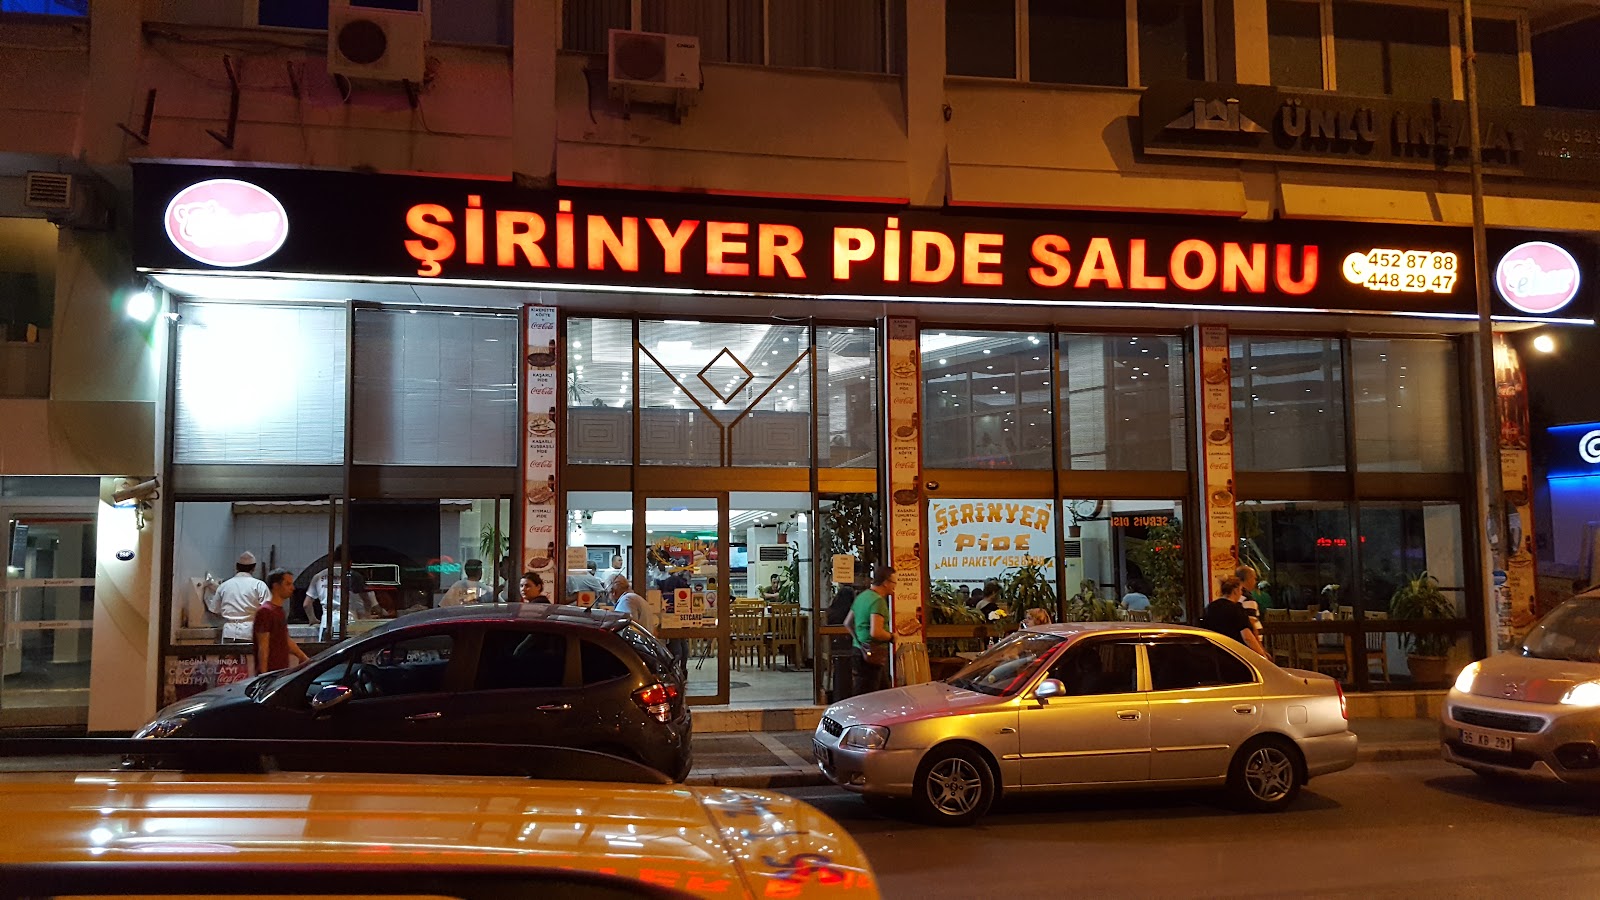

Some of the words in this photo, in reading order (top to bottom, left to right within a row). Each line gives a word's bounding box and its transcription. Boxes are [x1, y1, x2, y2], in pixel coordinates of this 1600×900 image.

[1281, 97, 1378, 143] ÜNLÜ
[404, 194, 808, 278] ŞİRİNYER
[833, 217, 1005, 287] PİDE
[1028, 234, 1320, 295] SALONU
[1369, 252, 1401, 269] 452
[1407, 254, 1428, 270] 87
[1433, 255, 1454, 271] 88
[1367, 272, 1400, 288] 448
[1406, 274, 1426, 289] 29
[1431, 275, 1453, 290] 47
[954, 533, 1032, 552] PİDE
[940, 556, 959, 568] ALO
[962, 556, 994, 568] PAKET
[1002, 555, 1020, 568] 452
[1464, 731, 1473, 744] 35
